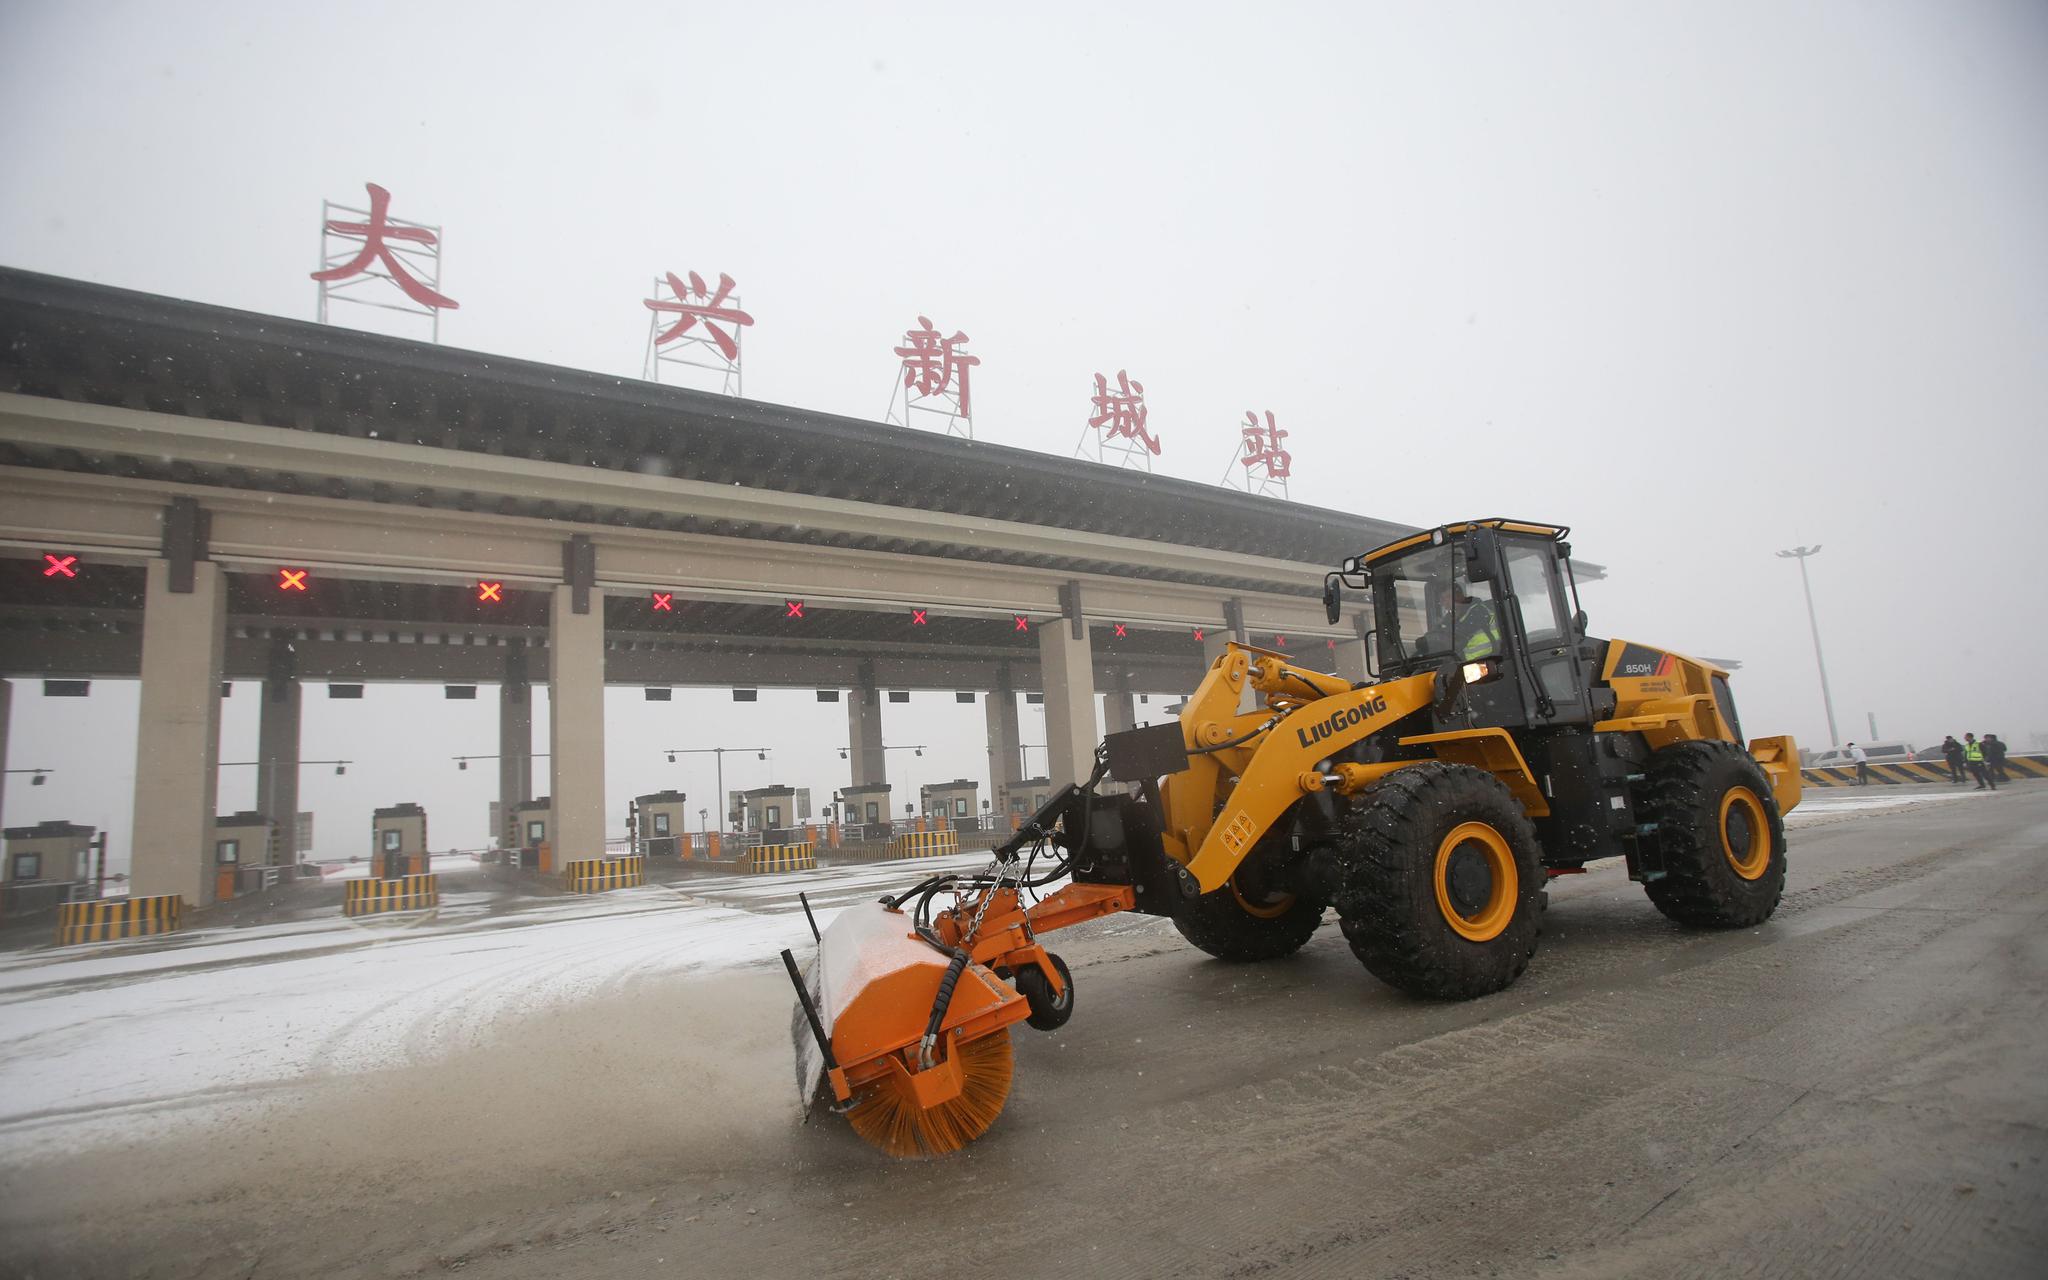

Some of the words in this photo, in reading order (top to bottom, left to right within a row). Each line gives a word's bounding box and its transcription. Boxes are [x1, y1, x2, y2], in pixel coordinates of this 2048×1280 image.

[310, 182, 1291, 479] 大兴新城站
[1625, 664, 1652, 674] 850H
